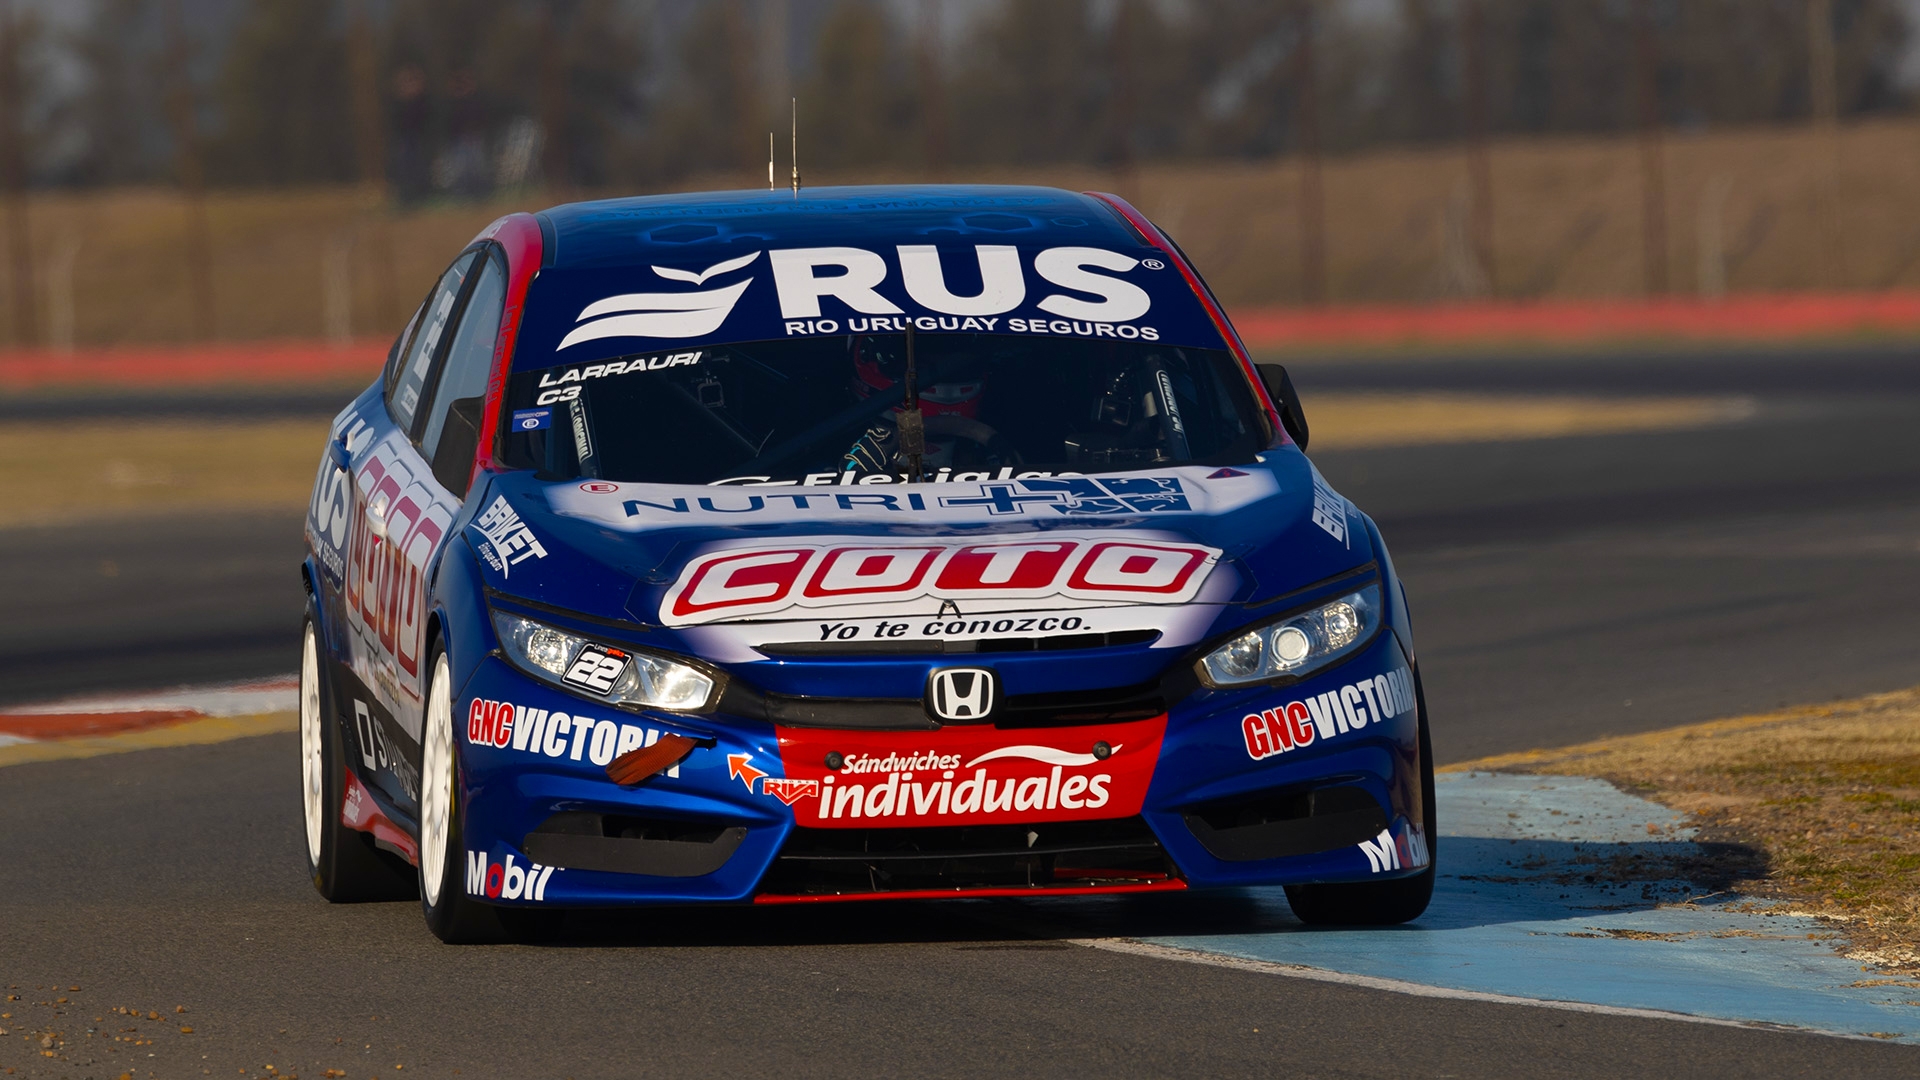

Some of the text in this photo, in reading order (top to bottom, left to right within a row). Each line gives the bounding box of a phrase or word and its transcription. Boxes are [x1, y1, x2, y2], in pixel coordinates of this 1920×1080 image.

[768, 244, 1151, 321] RUS
[785, 316, 1160, 341] RIO URUGUAY SEGUROS
[538, 351, 702, 388] LARRAURI
[536, 385, 583, 406] C3
[622, 493, 926, 518] NUTRI
[671, 540, 1211, 616] COTO
[820, 615, 1092, 641] Yo te conozco.
[565, 651, 625, 692] 22
[841, 751, 961, 775] Sándwiches
[763, 781, 819, 806] RIVA
[818, 766, 1112, 819] individuales
[466, 850, 555, 901] Mobil
